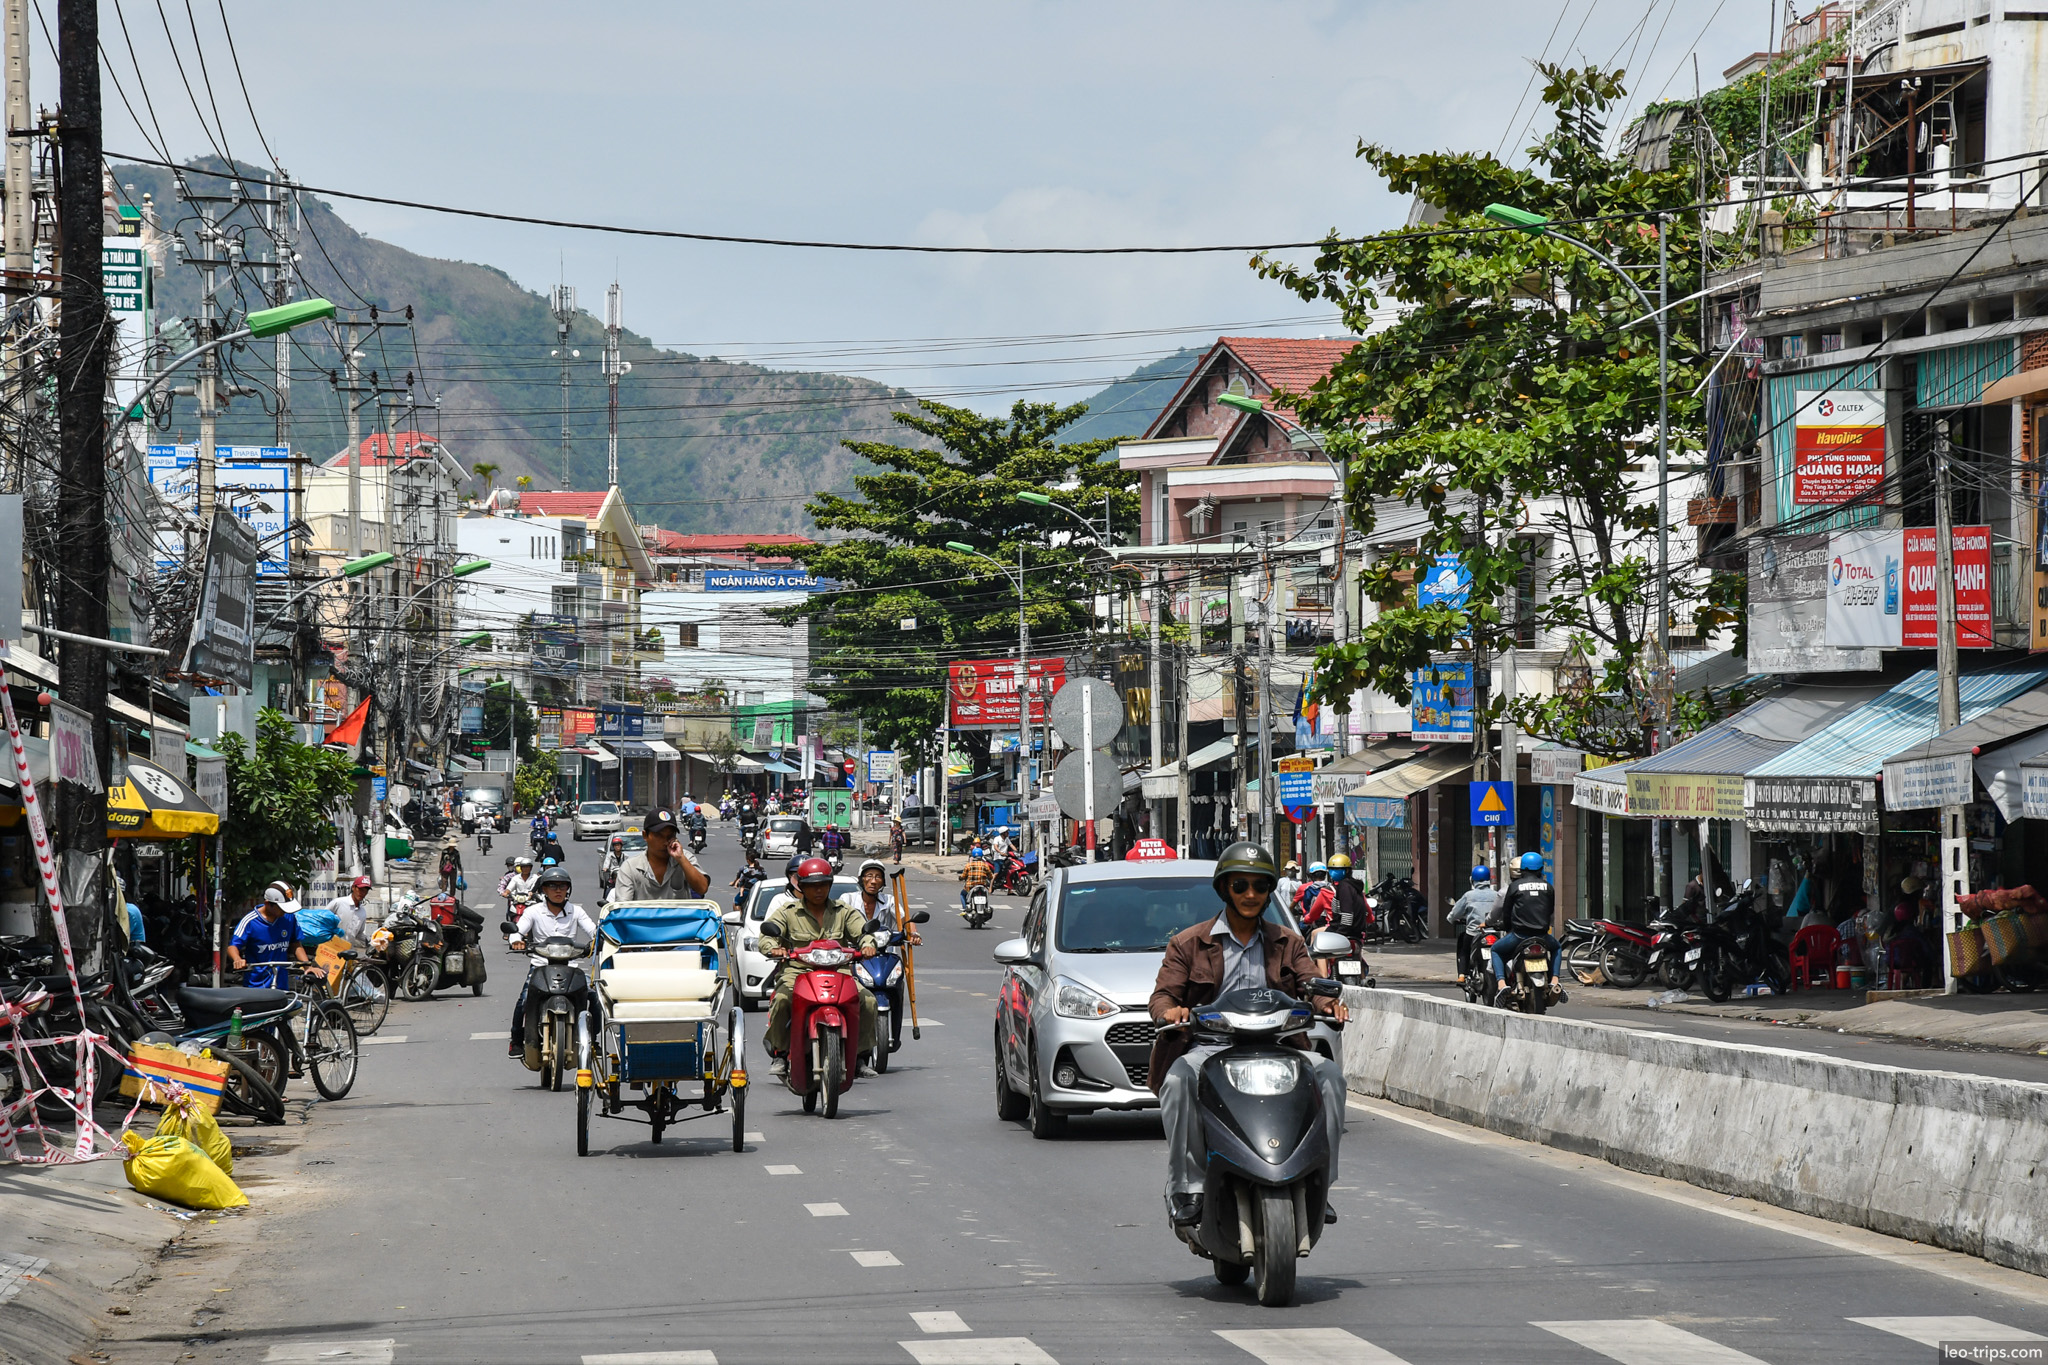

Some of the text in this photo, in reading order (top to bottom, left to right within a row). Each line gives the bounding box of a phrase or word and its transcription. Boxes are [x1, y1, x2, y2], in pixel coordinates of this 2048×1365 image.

[1837, 404, 1864, 412] CALTEX
[1816, 431, 1864, 445] Havoline
[1846, 454, 1871, 462] HONDA
[1966, 535, 1988, 550] HONDA
[1845, 563, 1874, 580] TOTAL
[711, 575, 741, 586] NGÂN
[744, 574, 776, 587] HÀNG
[787, 574, 818, 587] CHÂU
[1844, 585, 1880, 606] HI-PERF
[1484, 814, 1501, 823] CHỢ
[1140, 840, 1162, 848] METER
[1138, 848, 1166, 857] TAXI
[1518, 882, 1548, 891] GIVENCHY
